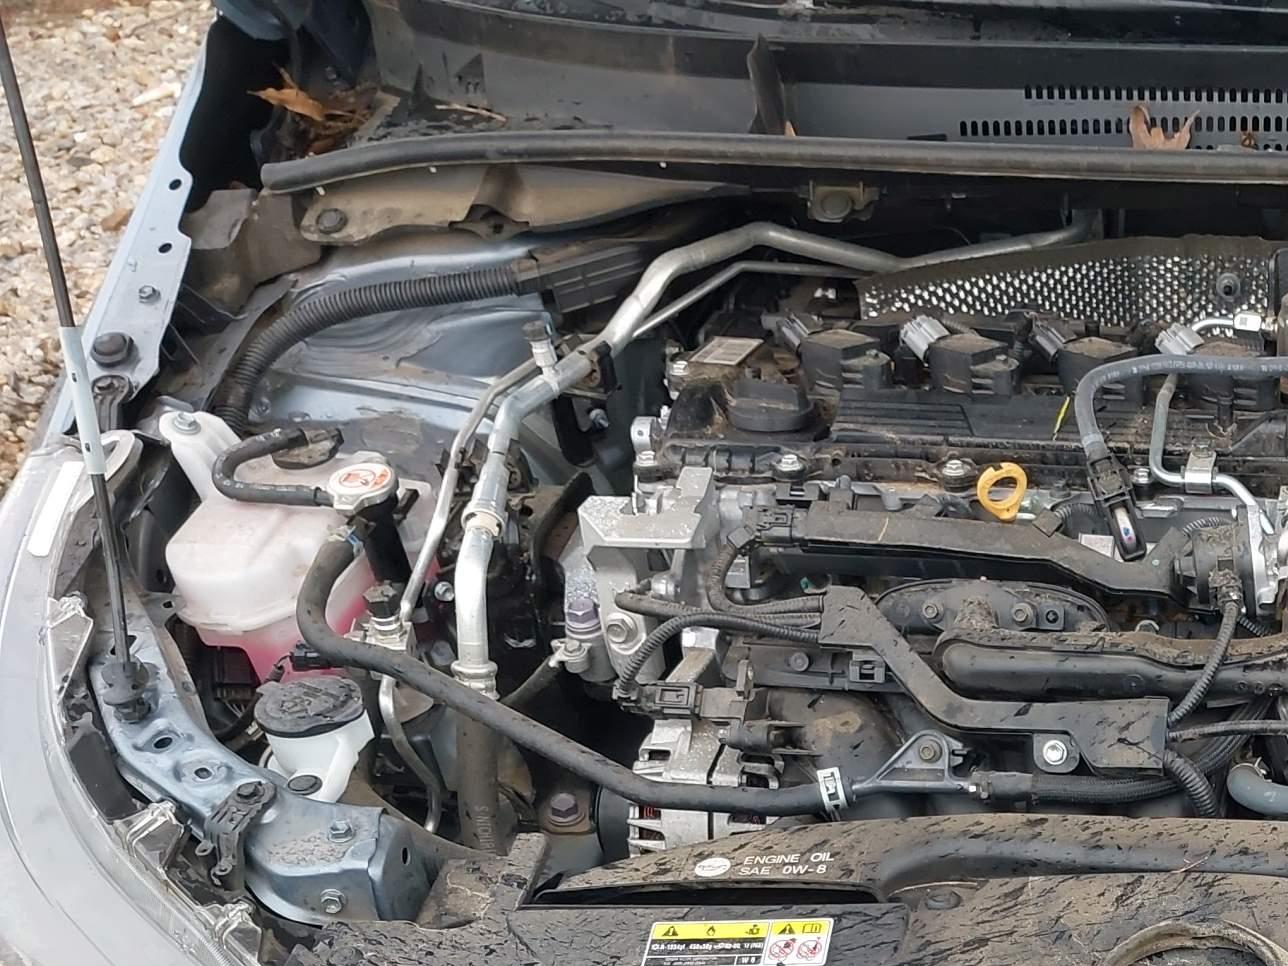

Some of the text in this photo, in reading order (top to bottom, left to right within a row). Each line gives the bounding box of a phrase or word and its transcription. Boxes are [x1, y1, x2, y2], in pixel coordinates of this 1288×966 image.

[744, 852, 834, 865] ENGINE OIL
[738, 864, 827, 876] SAE 0W-8
